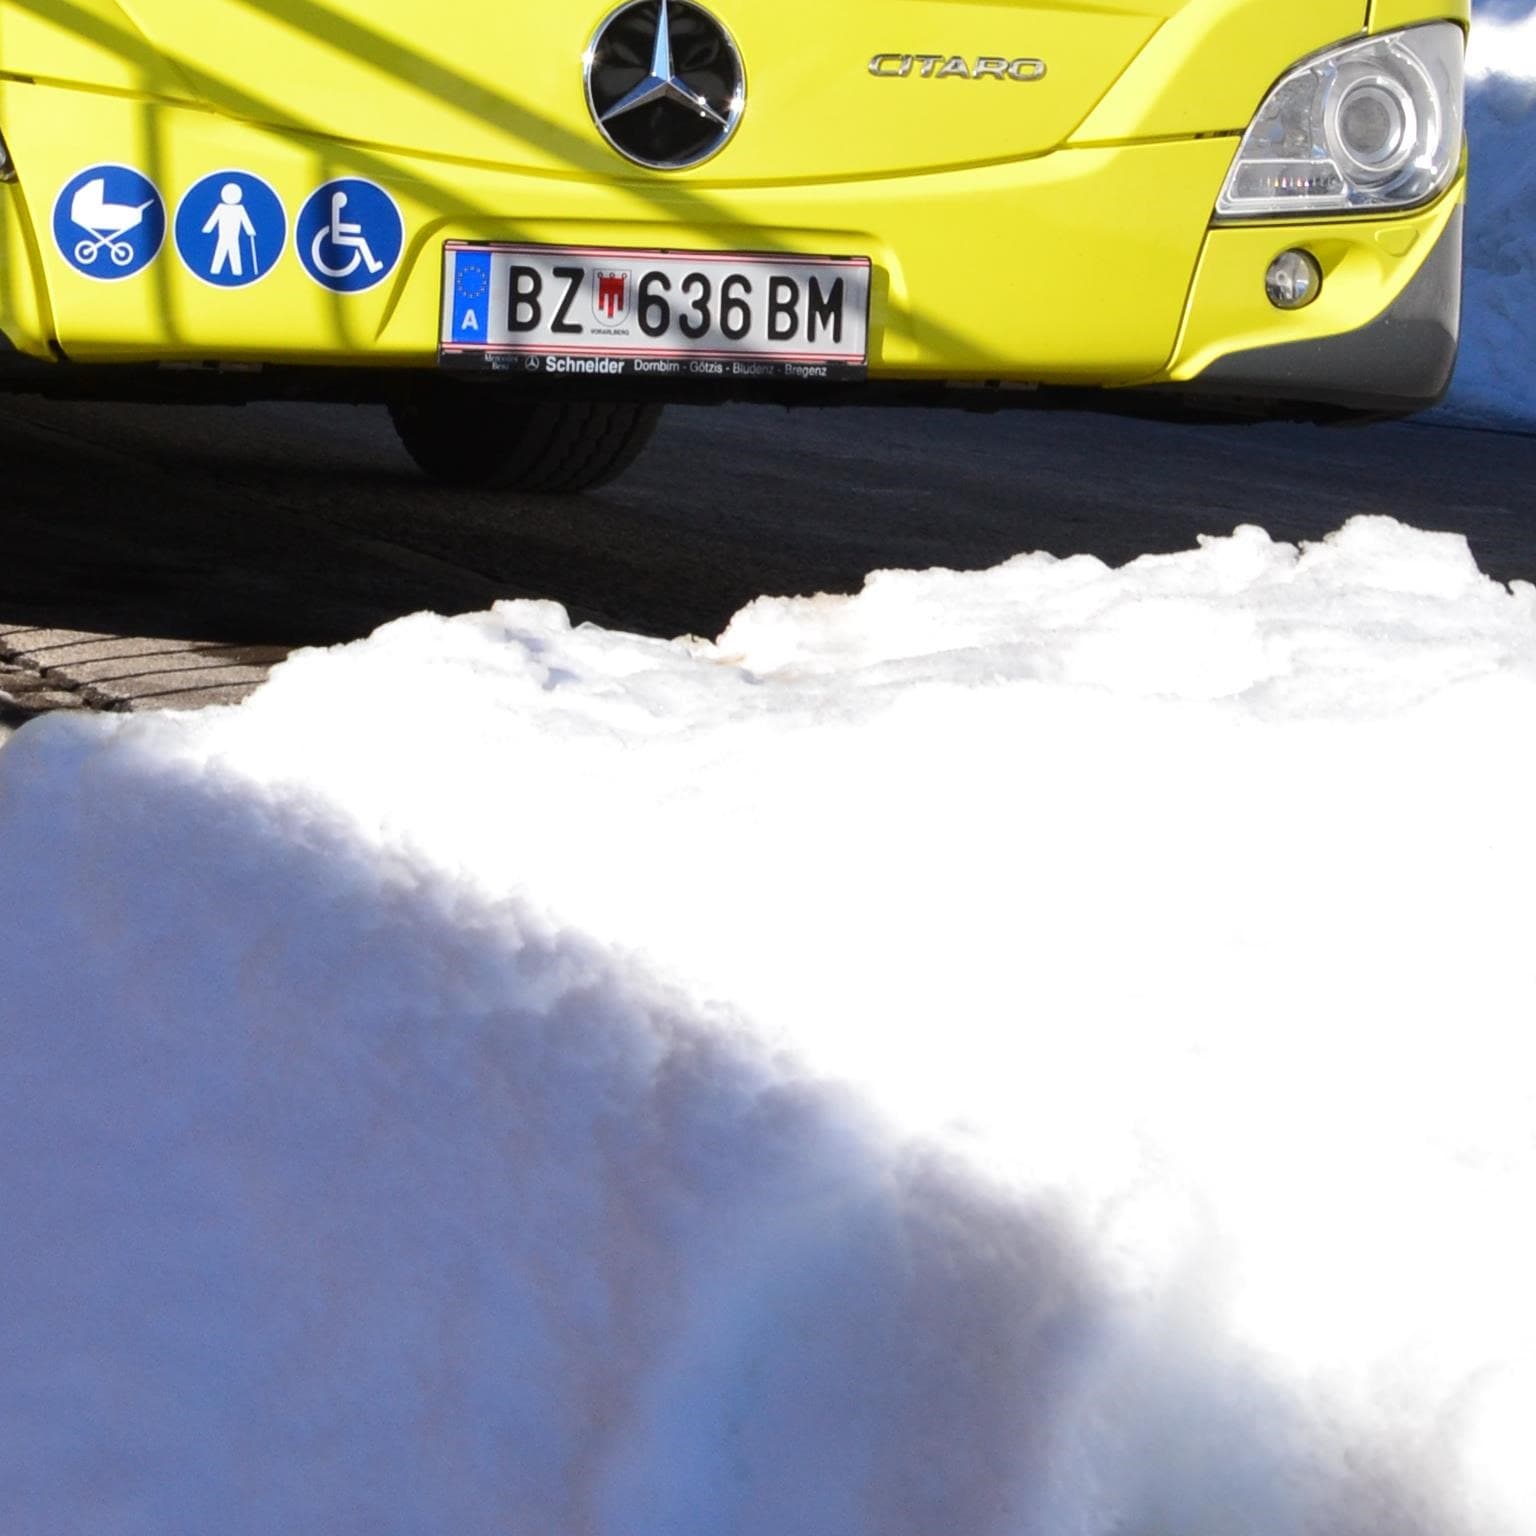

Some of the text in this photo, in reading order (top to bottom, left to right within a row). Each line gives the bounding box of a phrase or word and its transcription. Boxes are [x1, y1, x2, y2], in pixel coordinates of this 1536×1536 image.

[868, 54, 1047, 81] CITARO
[507, 265, 585, 334] BZ
[461, 309, 479, 330] A
[545, 356, 625, 374] Schneider
[785, 364, 828, 377] Bregenz
